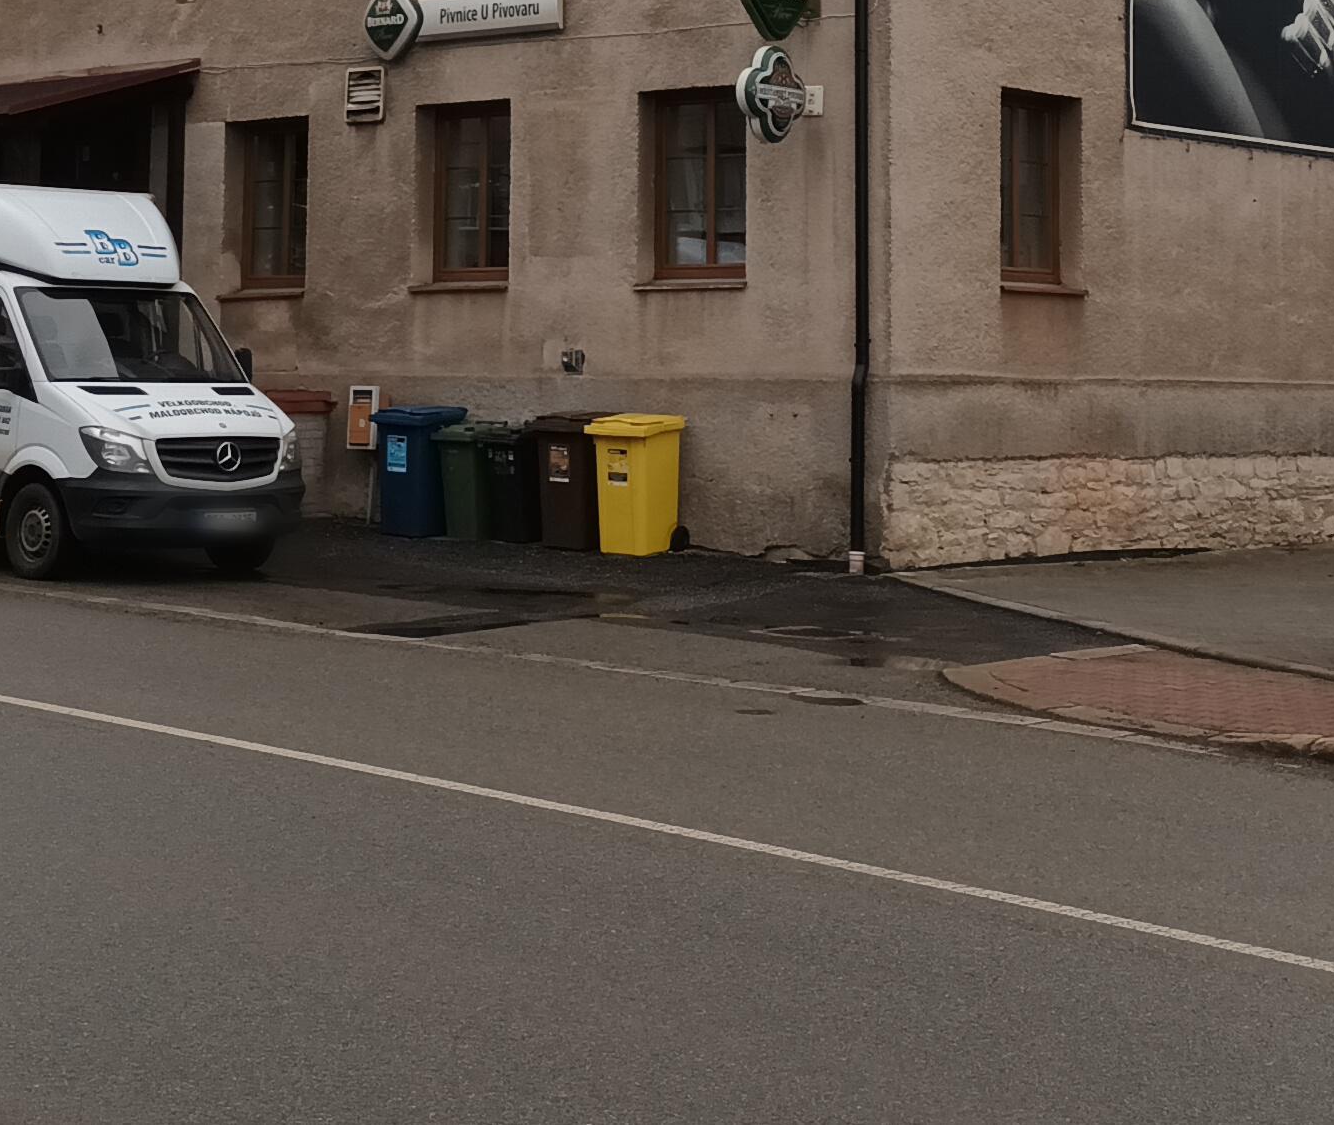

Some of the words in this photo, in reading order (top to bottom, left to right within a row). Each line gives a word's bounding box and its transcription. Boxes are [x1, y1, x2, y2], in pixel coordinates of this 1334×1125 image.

[439, 7, 478, 24] Pivnice
[481, 4, 489, 20] U
[492, 2, 540, 19] Pivovaru
